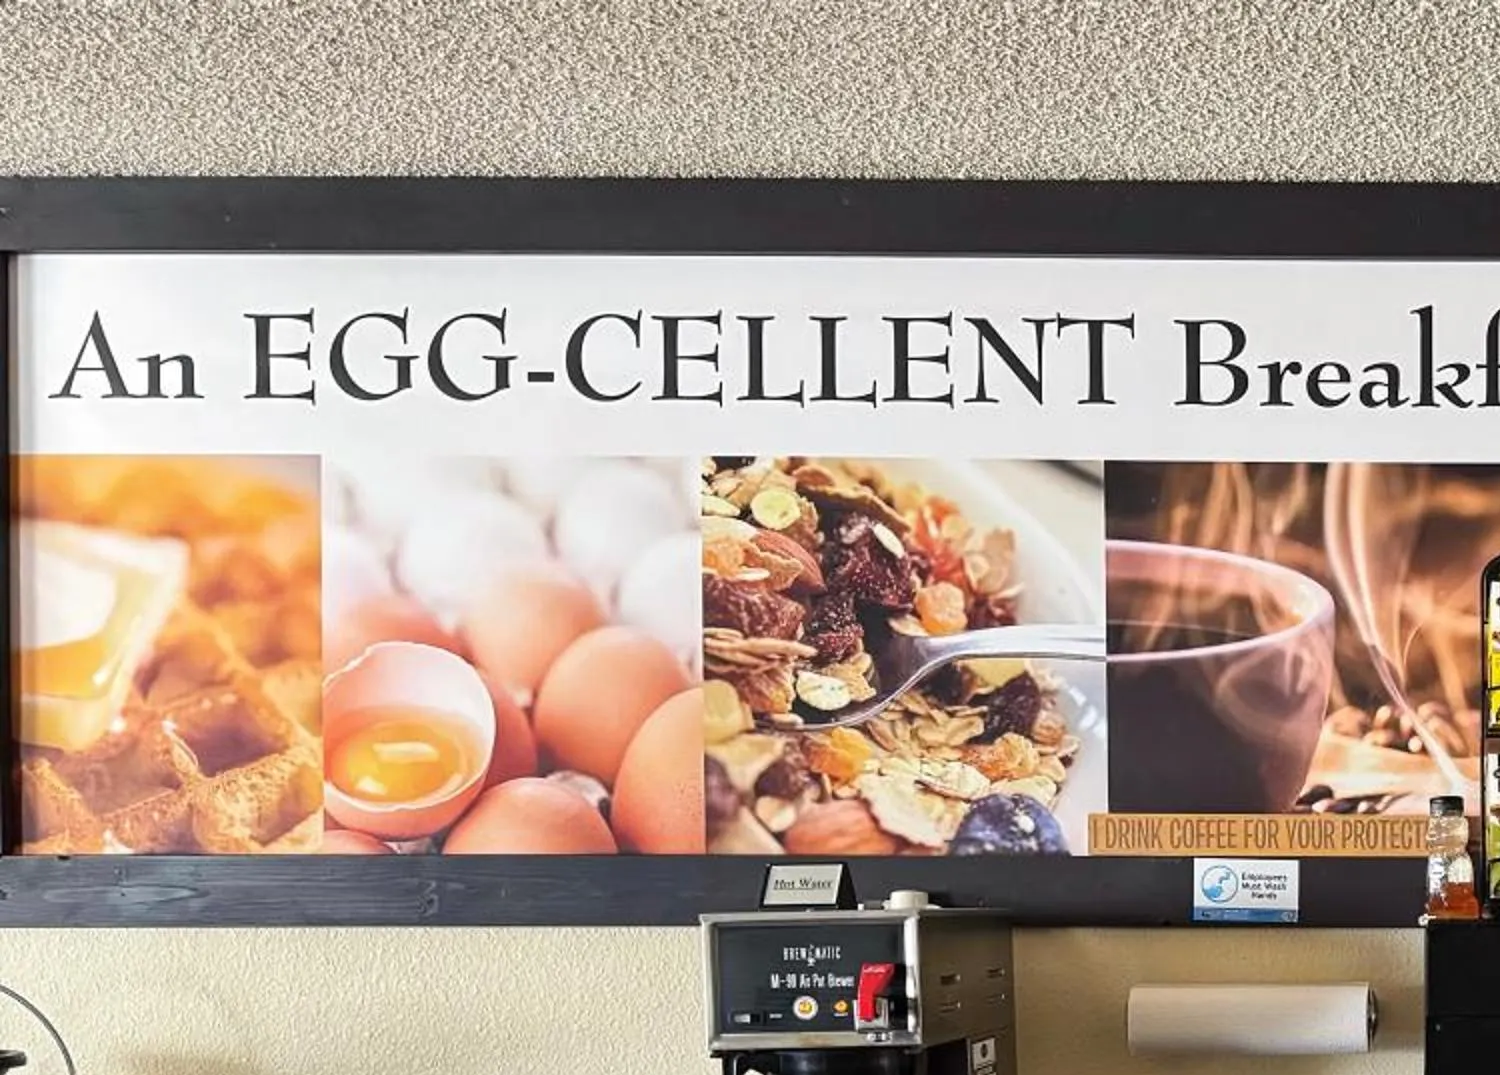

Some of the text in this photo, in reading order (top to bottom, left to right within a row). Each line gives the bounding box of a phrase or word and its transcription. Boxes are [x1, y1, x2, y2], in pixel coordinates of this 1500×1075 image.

[49, 312, 204, 399] An
[244, 308, 1134, 408] EGG-CELLENT
[1093, 819, 1098, 848] I
[1105, 819, 1163, 848] DRINK
[1169, 818, 1237, 849] COFFEE
[1243, 818, 1280, 849] FOR
[1285, 818, 1338, 849] YOUR
[774, 878, 832, 890] Hot Water
[1242, 873, 1288, 881] Employees
